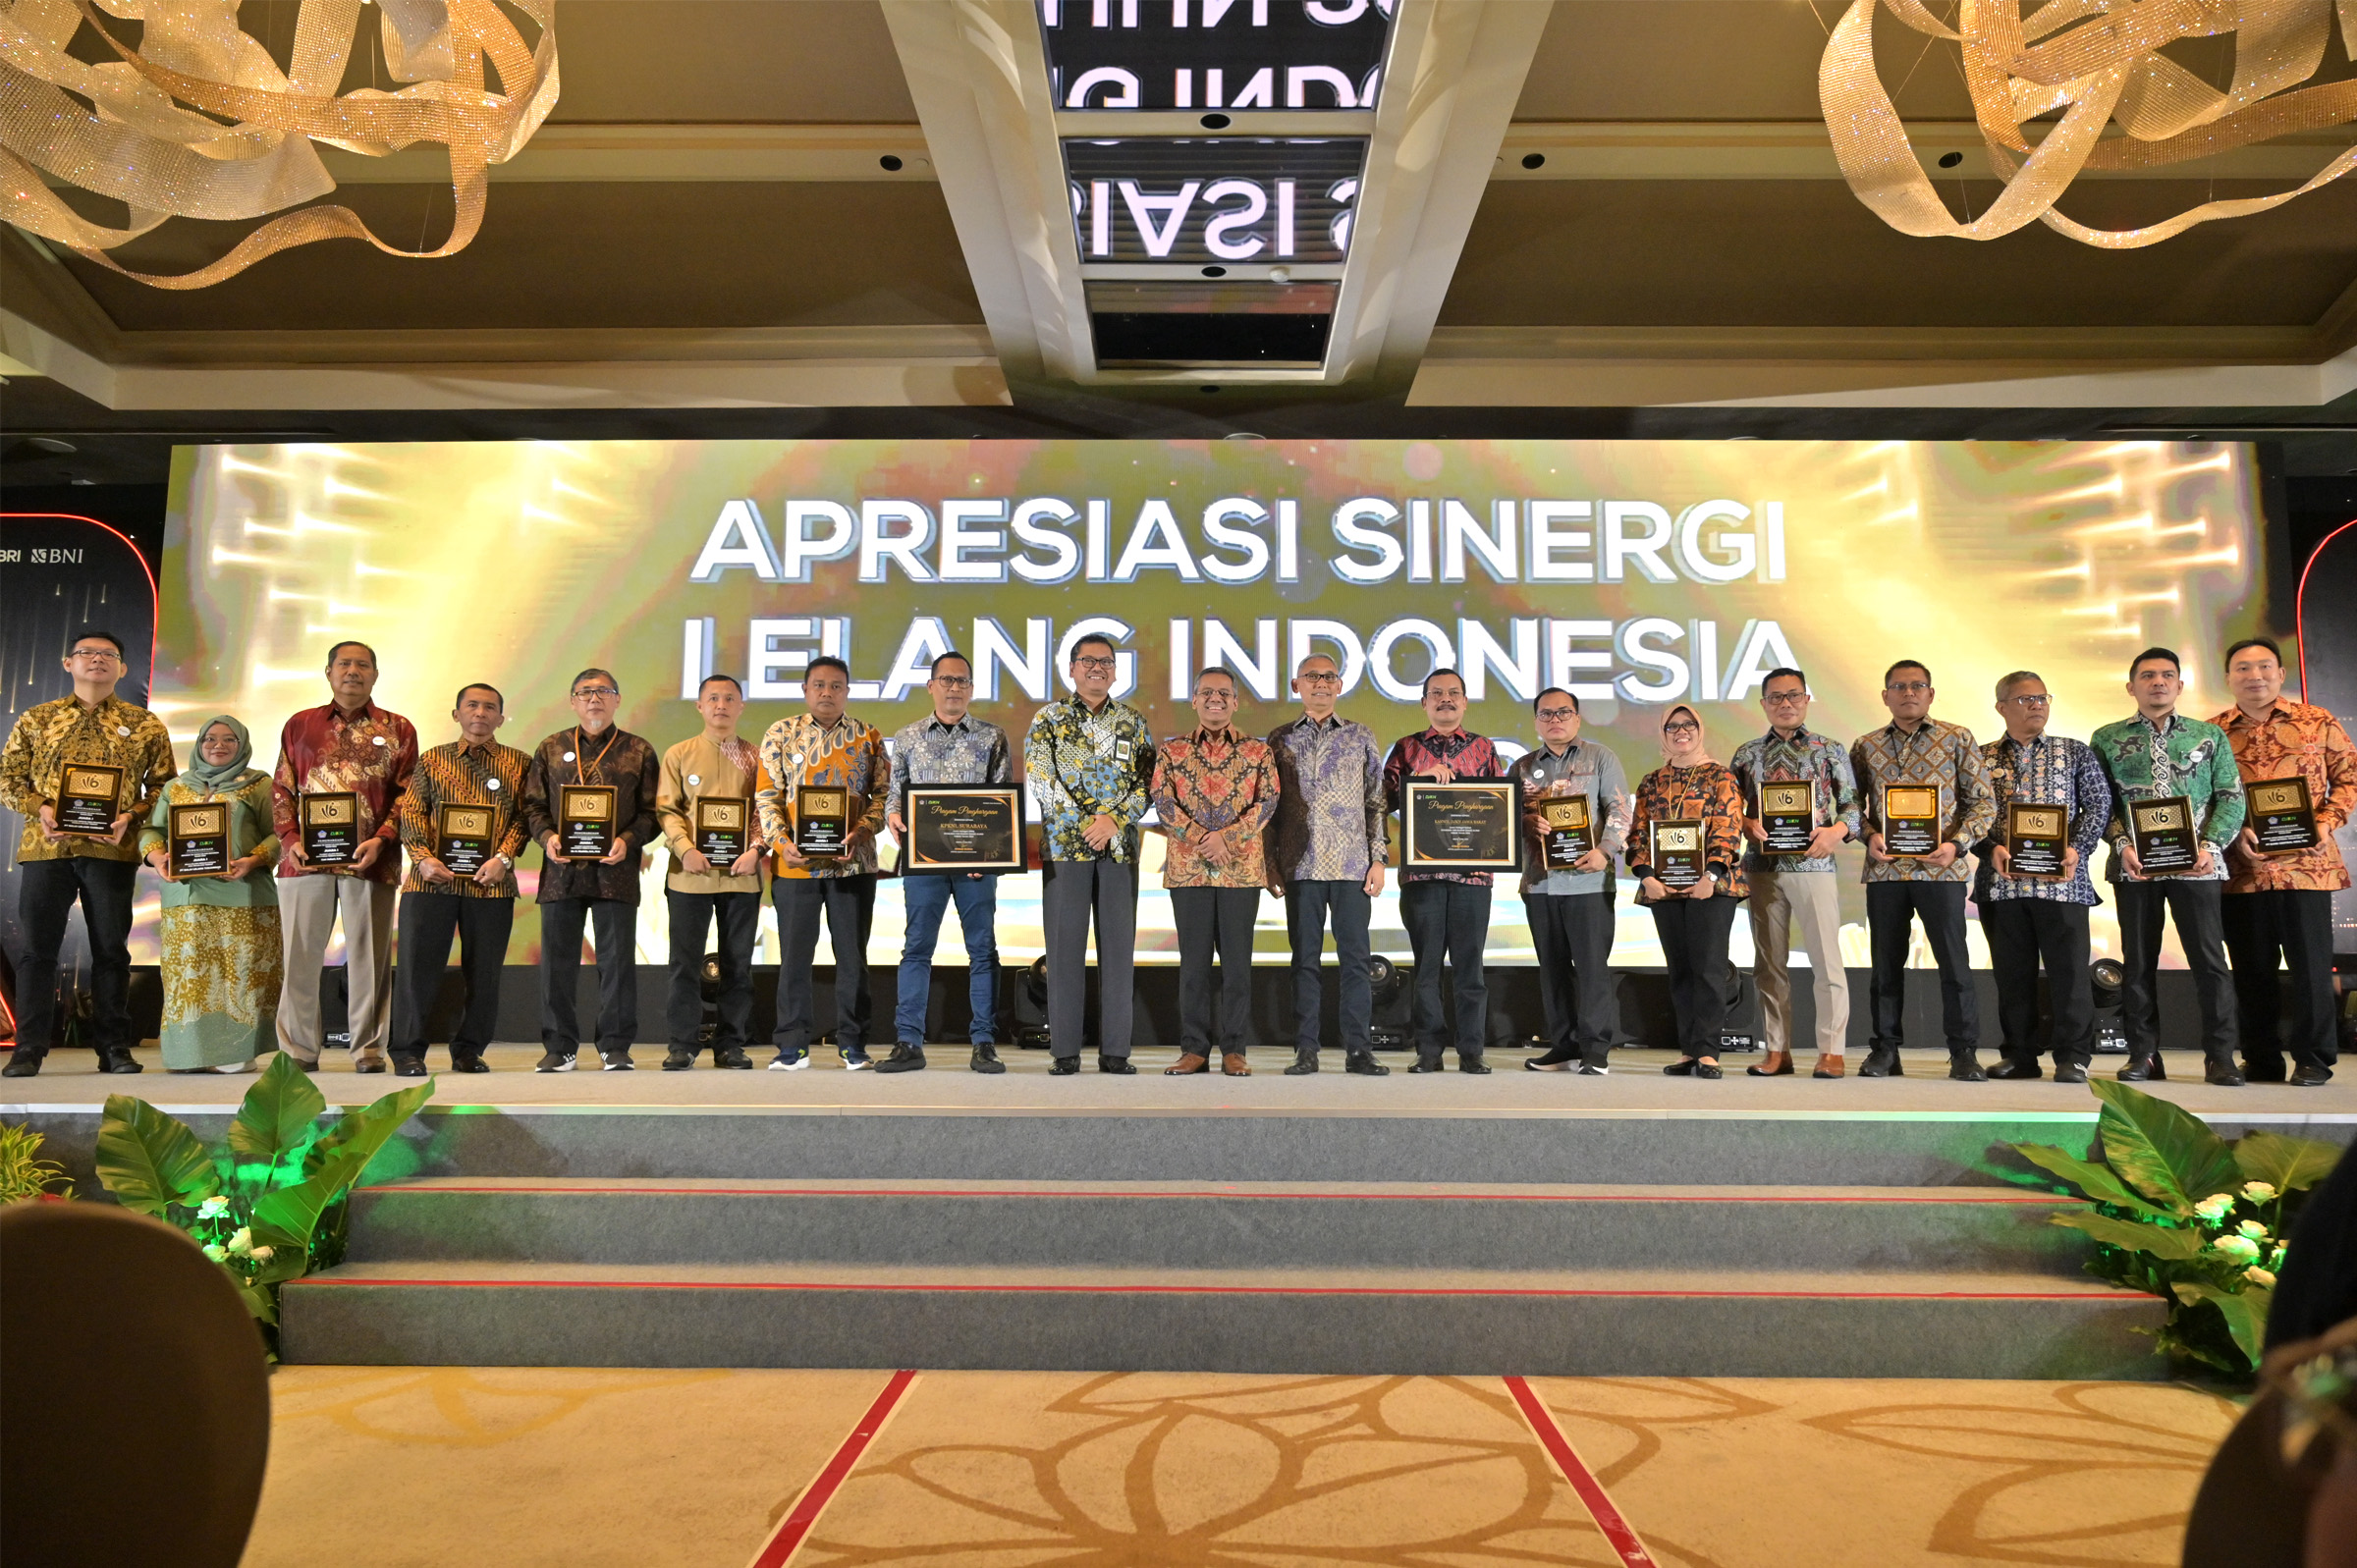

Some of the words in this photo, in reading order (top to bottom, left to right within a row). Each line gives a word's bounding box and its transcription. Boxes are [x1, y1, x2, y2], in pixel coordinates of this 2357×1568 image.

[690, 498, 1299, 582] APRESIASI
[1329, 498, 1786, 583] SINERGI
[0, 549, 21, 562] BRI
[49, 549, 83, 564] BNI
[681, 617, 1136, 701] LELANG
[1169, 617, 1813, 703] INDONESIA
[958, 806, 998, 817] Penghargaan
